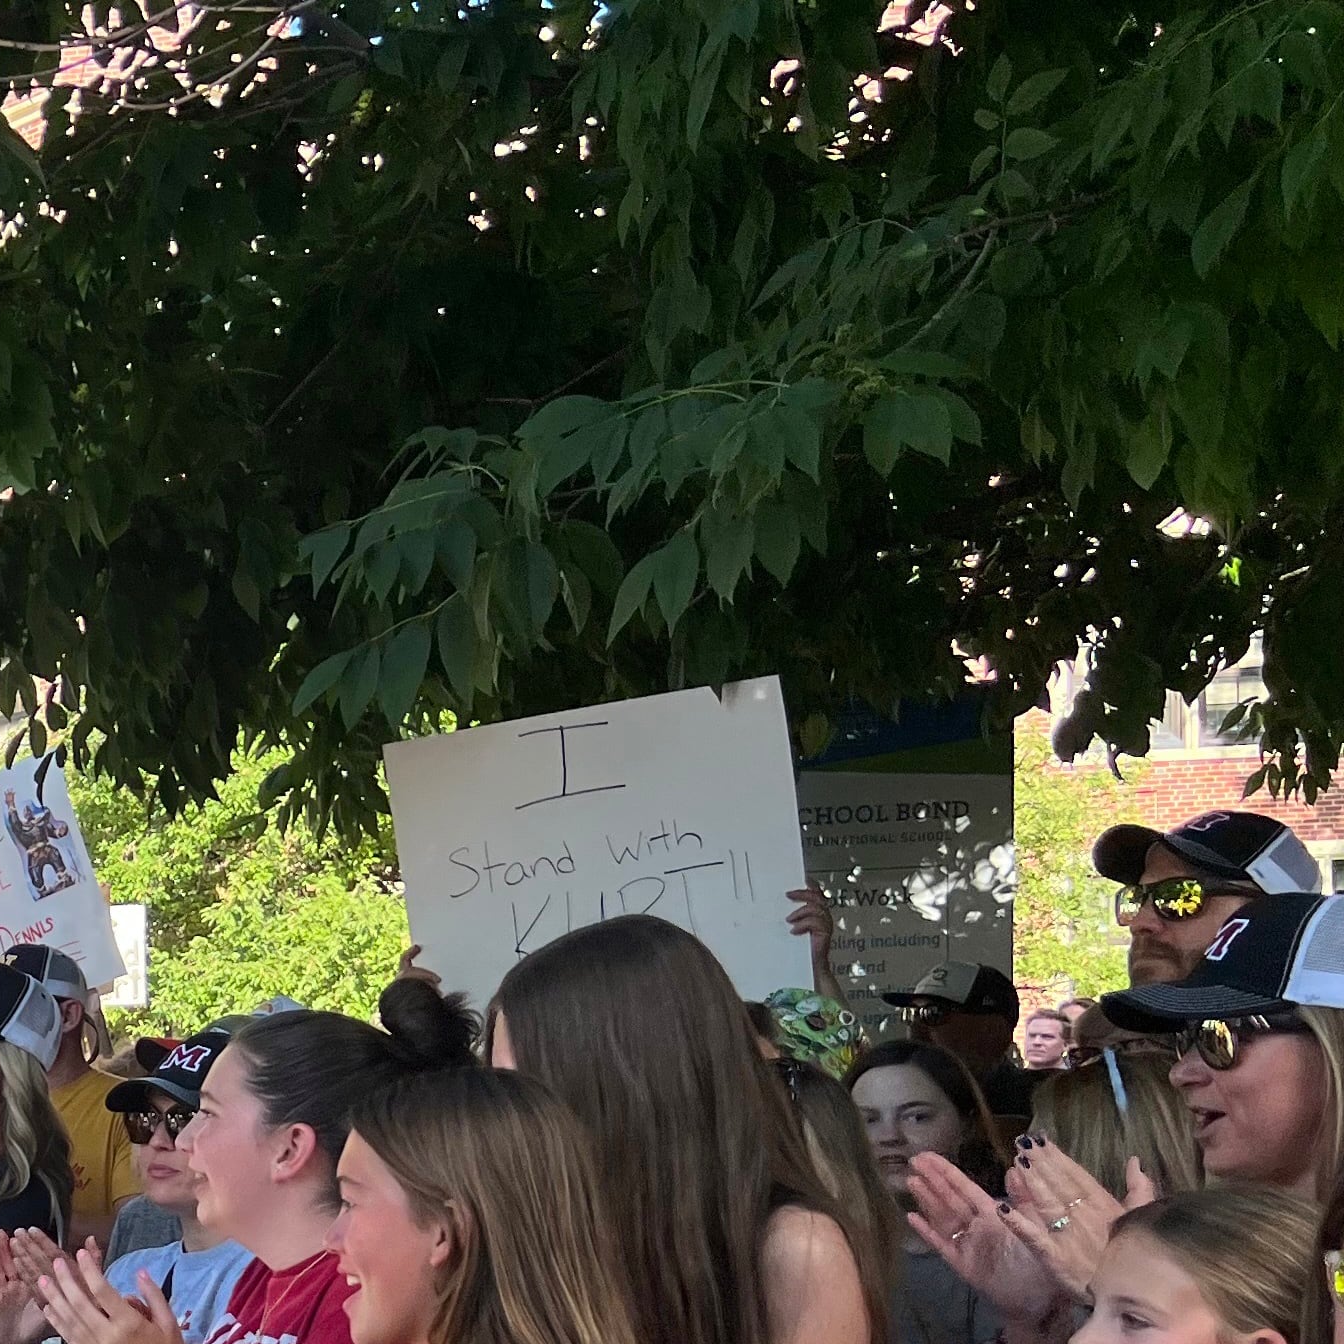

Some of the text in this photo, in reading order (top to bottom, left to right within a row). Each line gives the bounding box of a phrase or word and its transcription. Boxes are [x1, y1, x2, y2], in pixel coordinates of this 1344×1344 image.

[515, 721, 626, 810] I
[900, 830, 953, 845] SCHOOL
[449, 840, 576, 897] Stand
[870, 934, 941, 950] including
[158, 1043, 212, 1073] M
